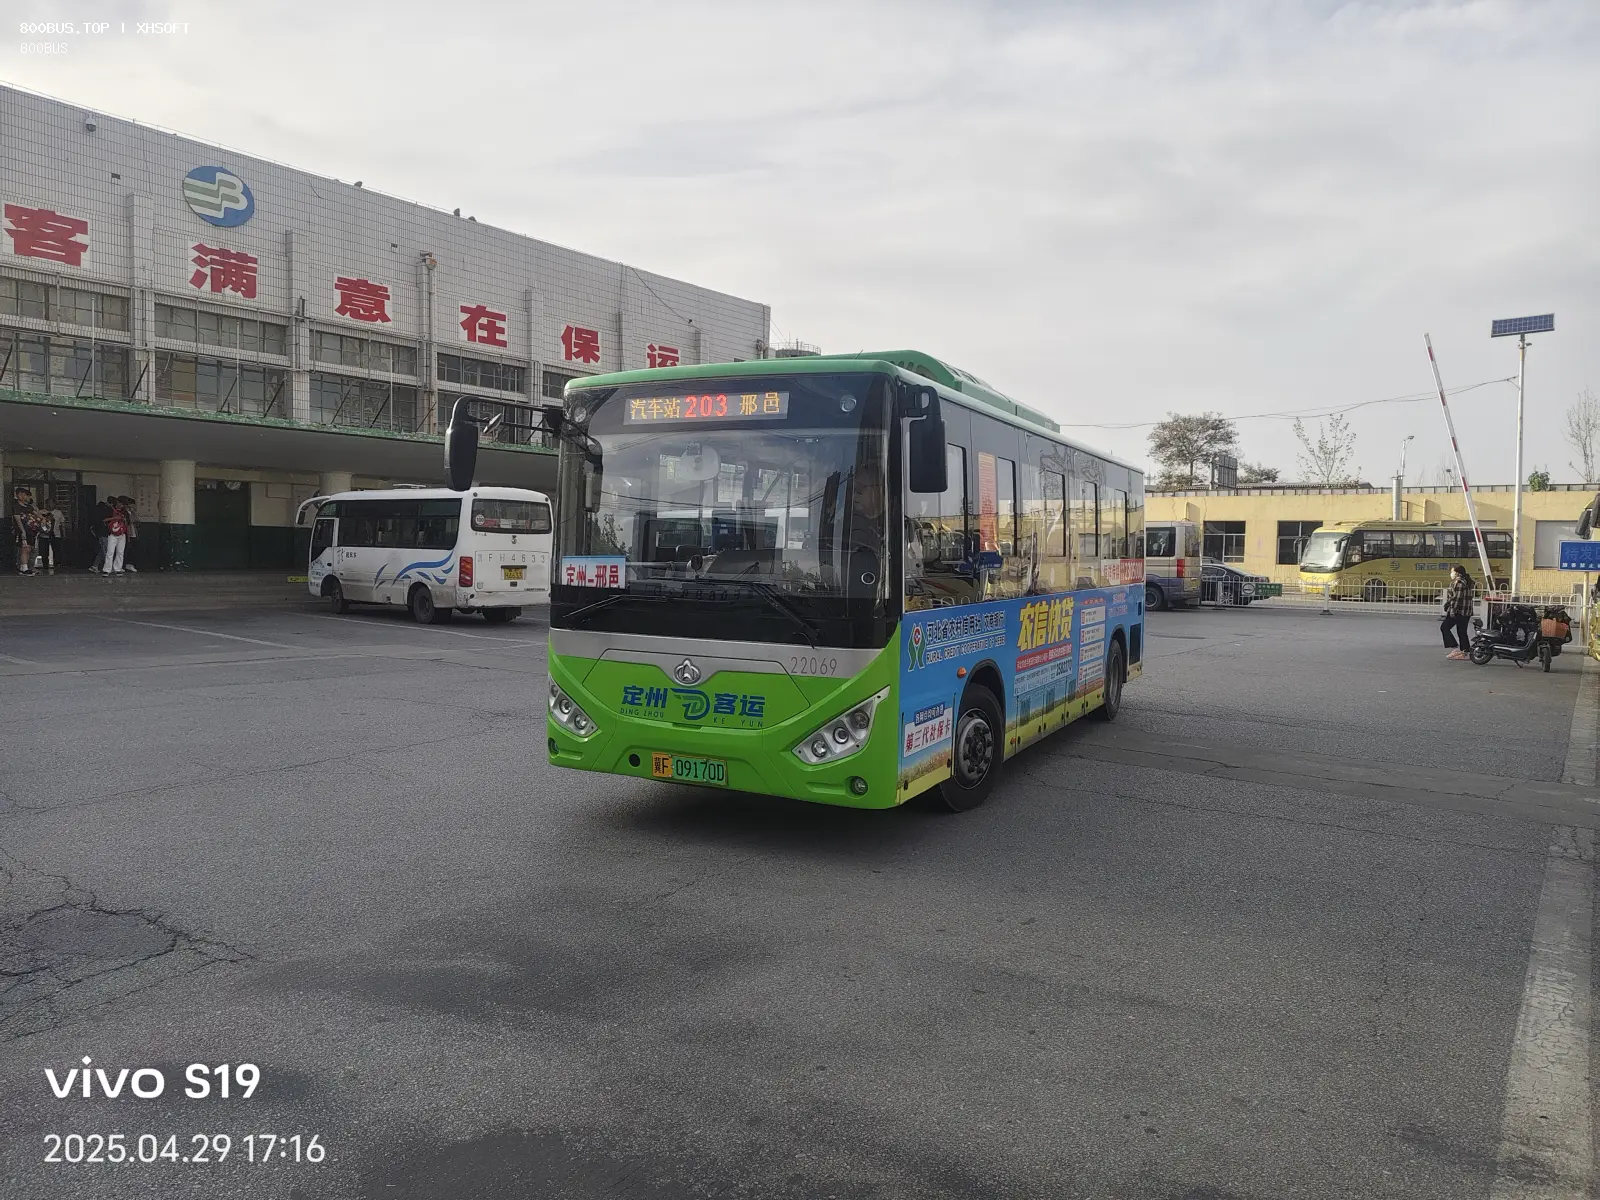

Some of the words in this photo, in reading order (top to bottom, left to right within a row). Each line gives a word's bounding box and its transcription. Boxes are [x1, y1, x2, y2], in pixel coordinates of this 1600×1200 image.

[630, 397, 681, 420] 汽车站
[684, 394, 728, 417] 203
[790, 656, 838, 676] 22069
[620, 707, 640, 716] DING
[643, 707, 664, 718] ZHOU
[621, 685, 669, 709] 定州
[713, 693, 766, 718] 客运
[905, 716, 951, 752] 第三代社保卡
